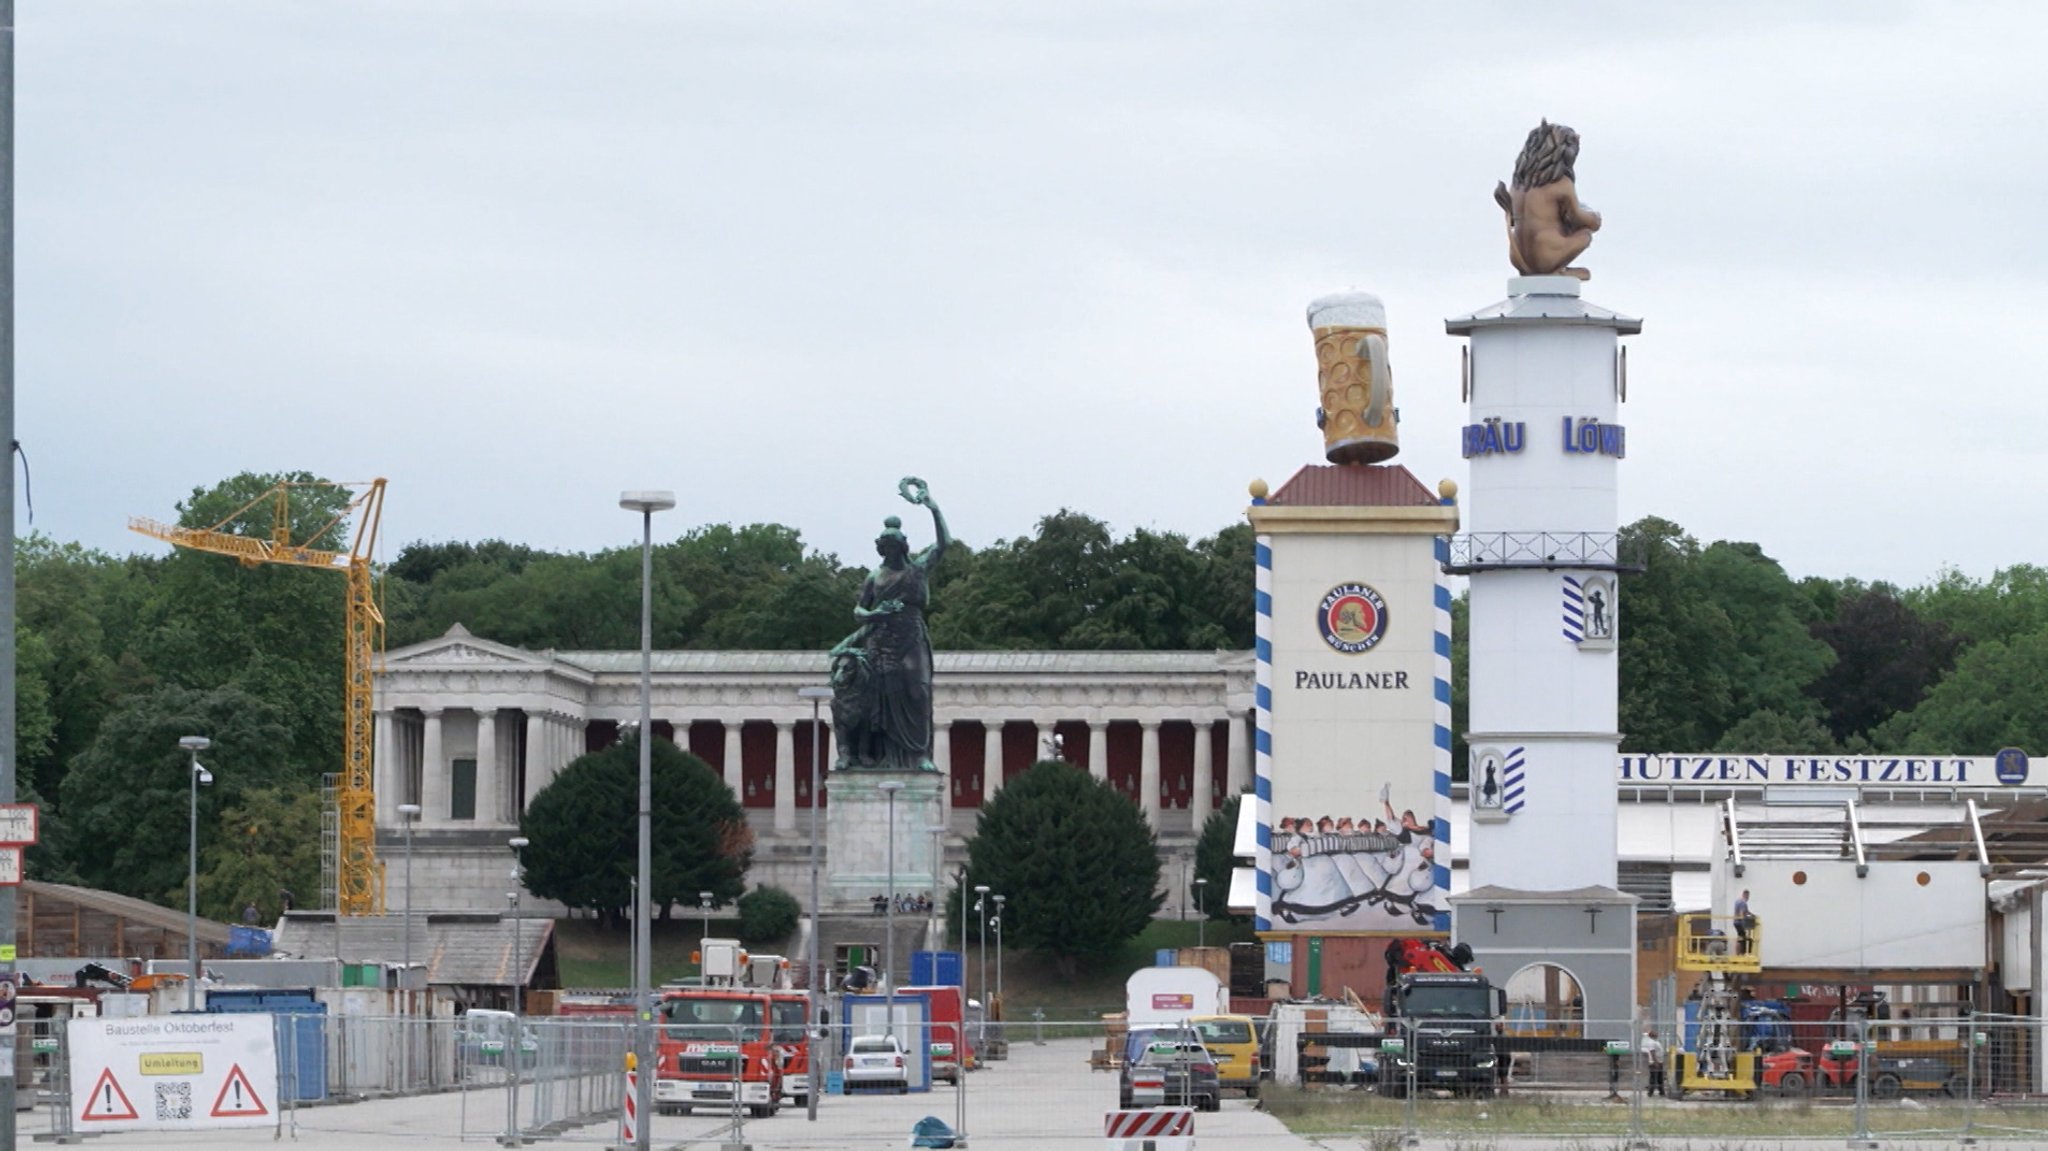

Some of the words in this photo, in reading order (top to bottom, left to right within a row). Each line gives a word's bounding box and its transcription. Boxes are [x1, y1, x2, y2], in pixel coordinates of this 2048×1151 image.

[1321, 585, 1384, 610] PAULANER
[1295, 671, 1409, 689] PAULANER
[1784, 758, 1974, 782] FESTZELT
[105, 1023, 160, 1036] Baustelle
[164, 1021, 234, 1034] Oktoberfest
[144, 1058, 199, 1069] Umleitung
